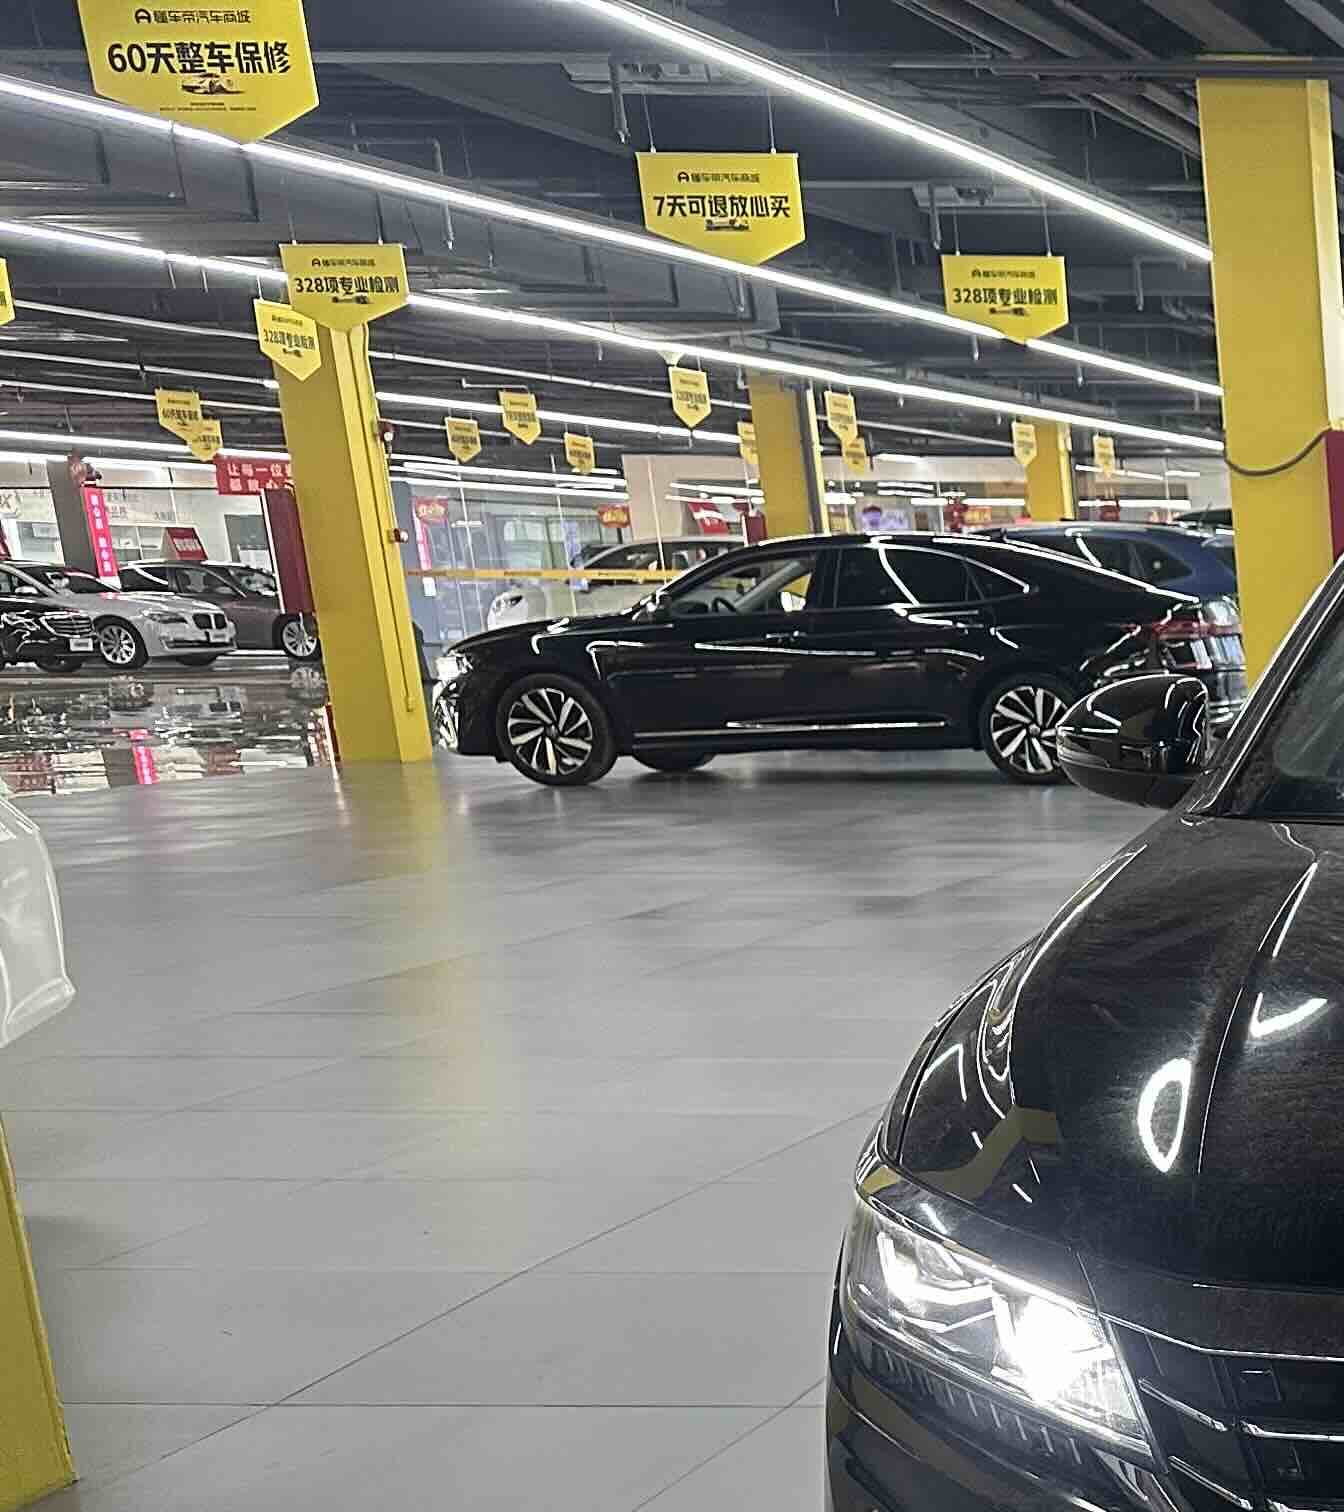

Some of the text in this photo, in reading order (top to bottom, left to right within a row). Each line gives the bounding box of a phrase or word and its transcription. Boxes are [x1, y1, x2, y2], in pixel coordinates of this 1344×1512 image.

[107, 41, 291, 75] 60天整车保修
[653, 195, 790, 217] 7天可退放心买
[294, 276, 400, 294] 328项专业检测
[953, 288, 1058, 305] 328项专业检测
